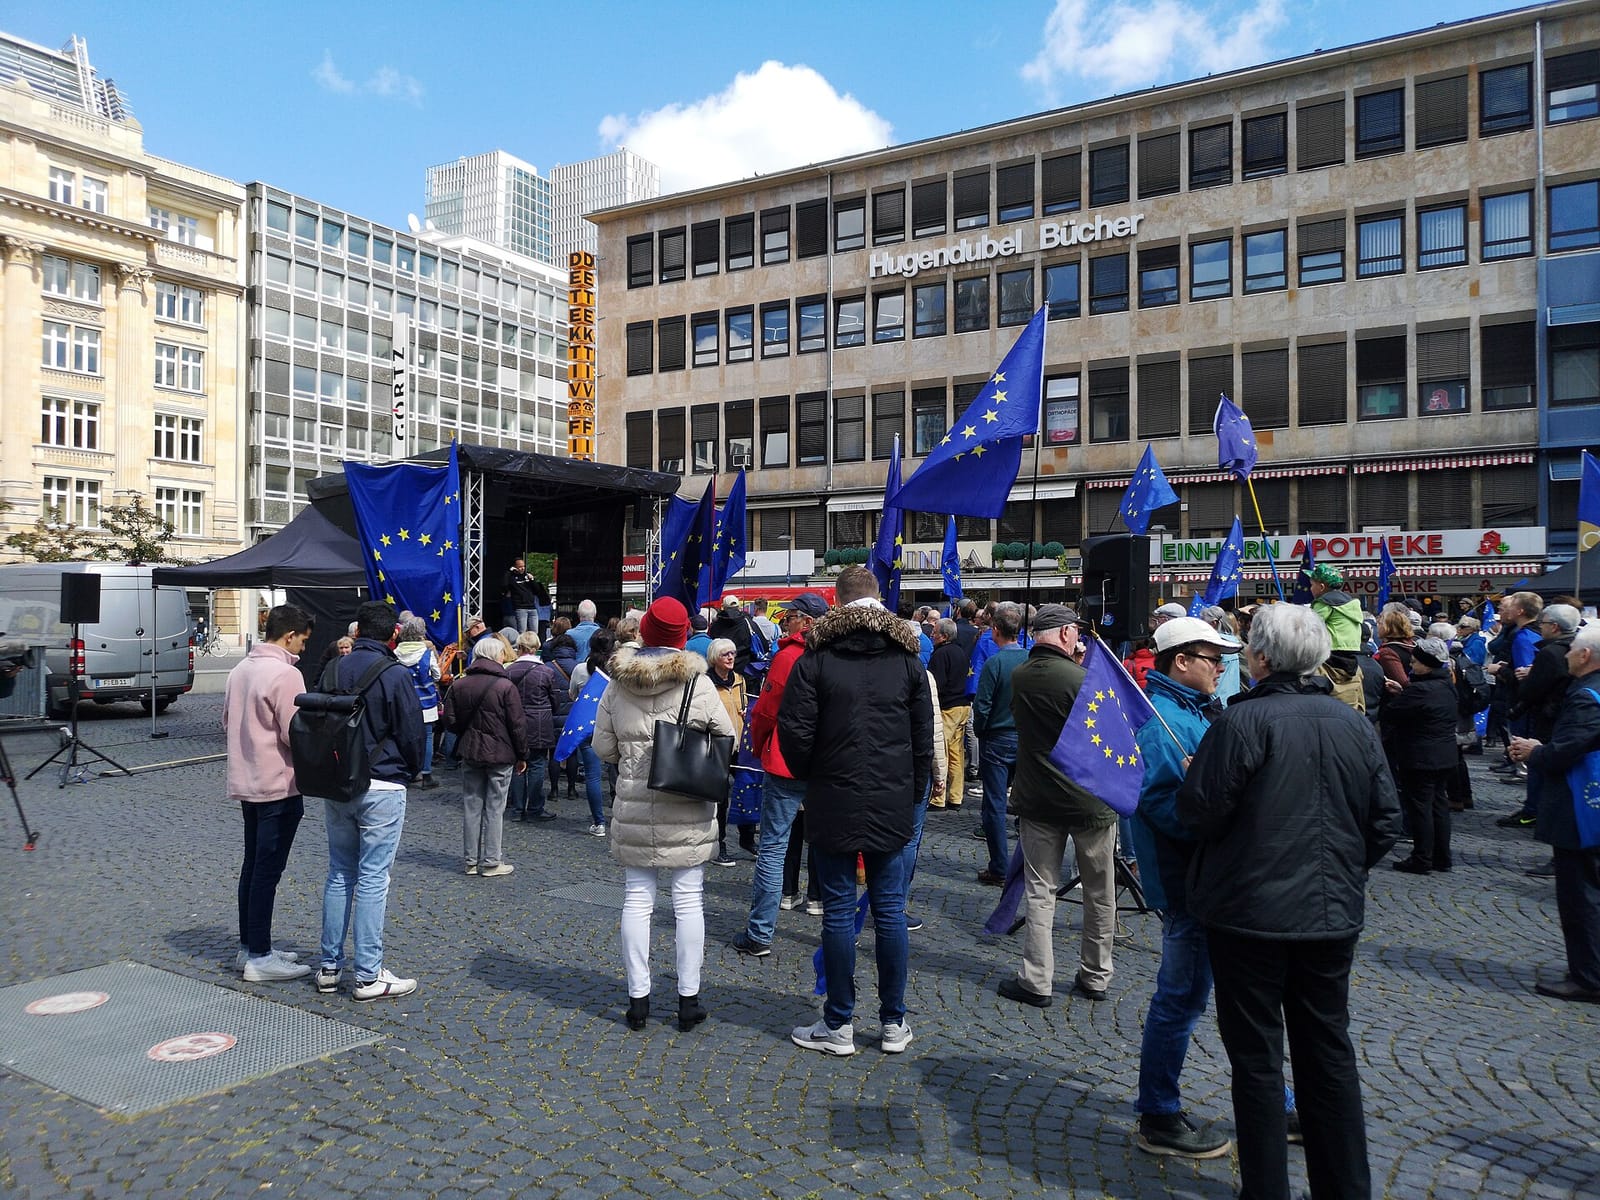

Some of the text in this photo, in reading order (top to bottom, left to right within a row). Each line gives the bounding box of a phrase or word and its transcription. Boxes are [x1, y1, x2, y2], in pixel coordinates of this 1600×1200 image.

[869, 213, 1145, 278] Hugendubel Bücher
[1163, 534, 1443, 561] EINHRN APOTHEKE
[1256, 580, 1437, 595] EINH APOHEKE
